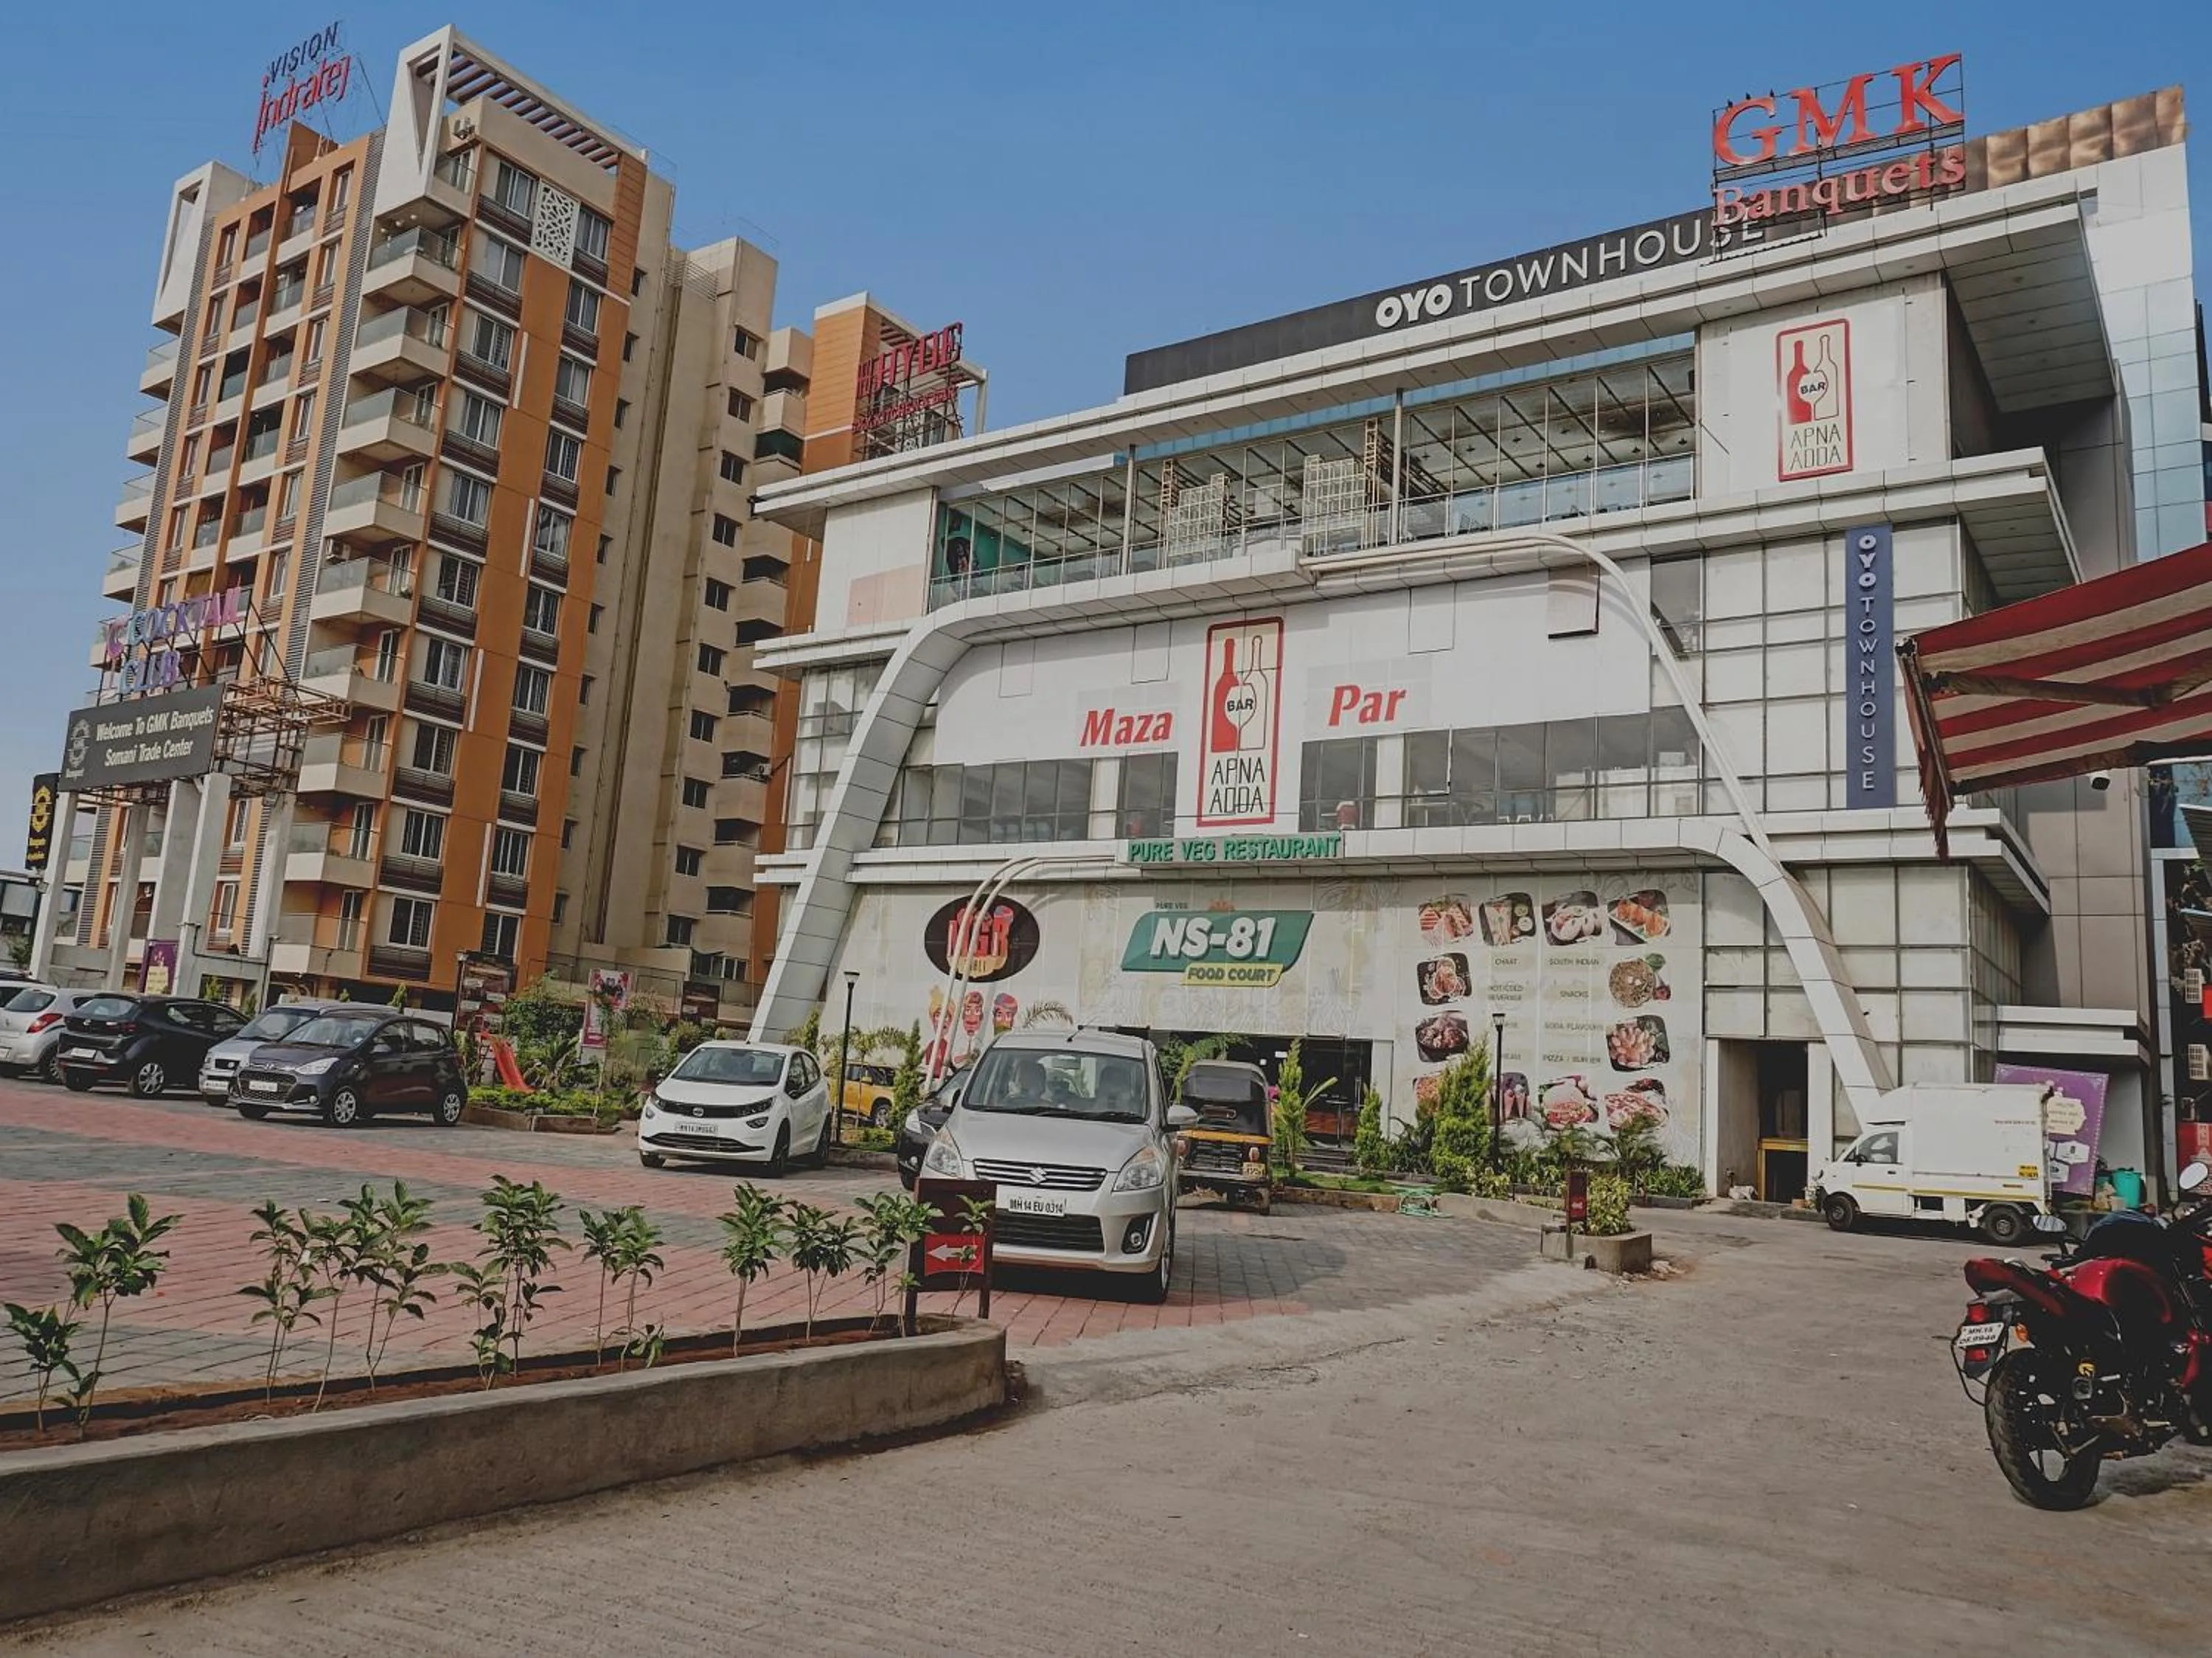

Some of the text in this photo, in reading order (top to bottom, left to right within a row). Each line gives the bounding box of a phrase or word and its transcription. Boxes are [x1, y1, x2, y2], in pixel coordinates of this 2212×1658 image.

[269, 21, 338, 83] VISION
[1713, 54, 1964, 167] GMK
[1712, 147, 1966, 229] Banquets
[1375, 284, 1453, 329] OYO
[1800, 381, 1826, 395] BAR
[1790, 423, 1842, 449] APNA
[1790, 445, 1842, 471] ADDA
[119, 649, 181, 695] CLUB
[1858, 534, 1878, 790] OYO TOWNHOUSE
[96, 705, 214, 741] Welcome To GMK Banquets
[1226, 698, 1254, 712] BAR
[1329, 684, 1408, 726] Par
[1079, 708, 1173, 746] Maza
[104, 738, 194, 767] Somani Trade Center
[1211, 757, 1265, 785] APNA
[1209, 786, 1265, 814] ADDA
[1129, 833, 1342, 862] PURE VEG RESTAURANT
[1150, 916, 1277, 959] NS-81
[1186, 967, 1277, 982] FOOD COURT
